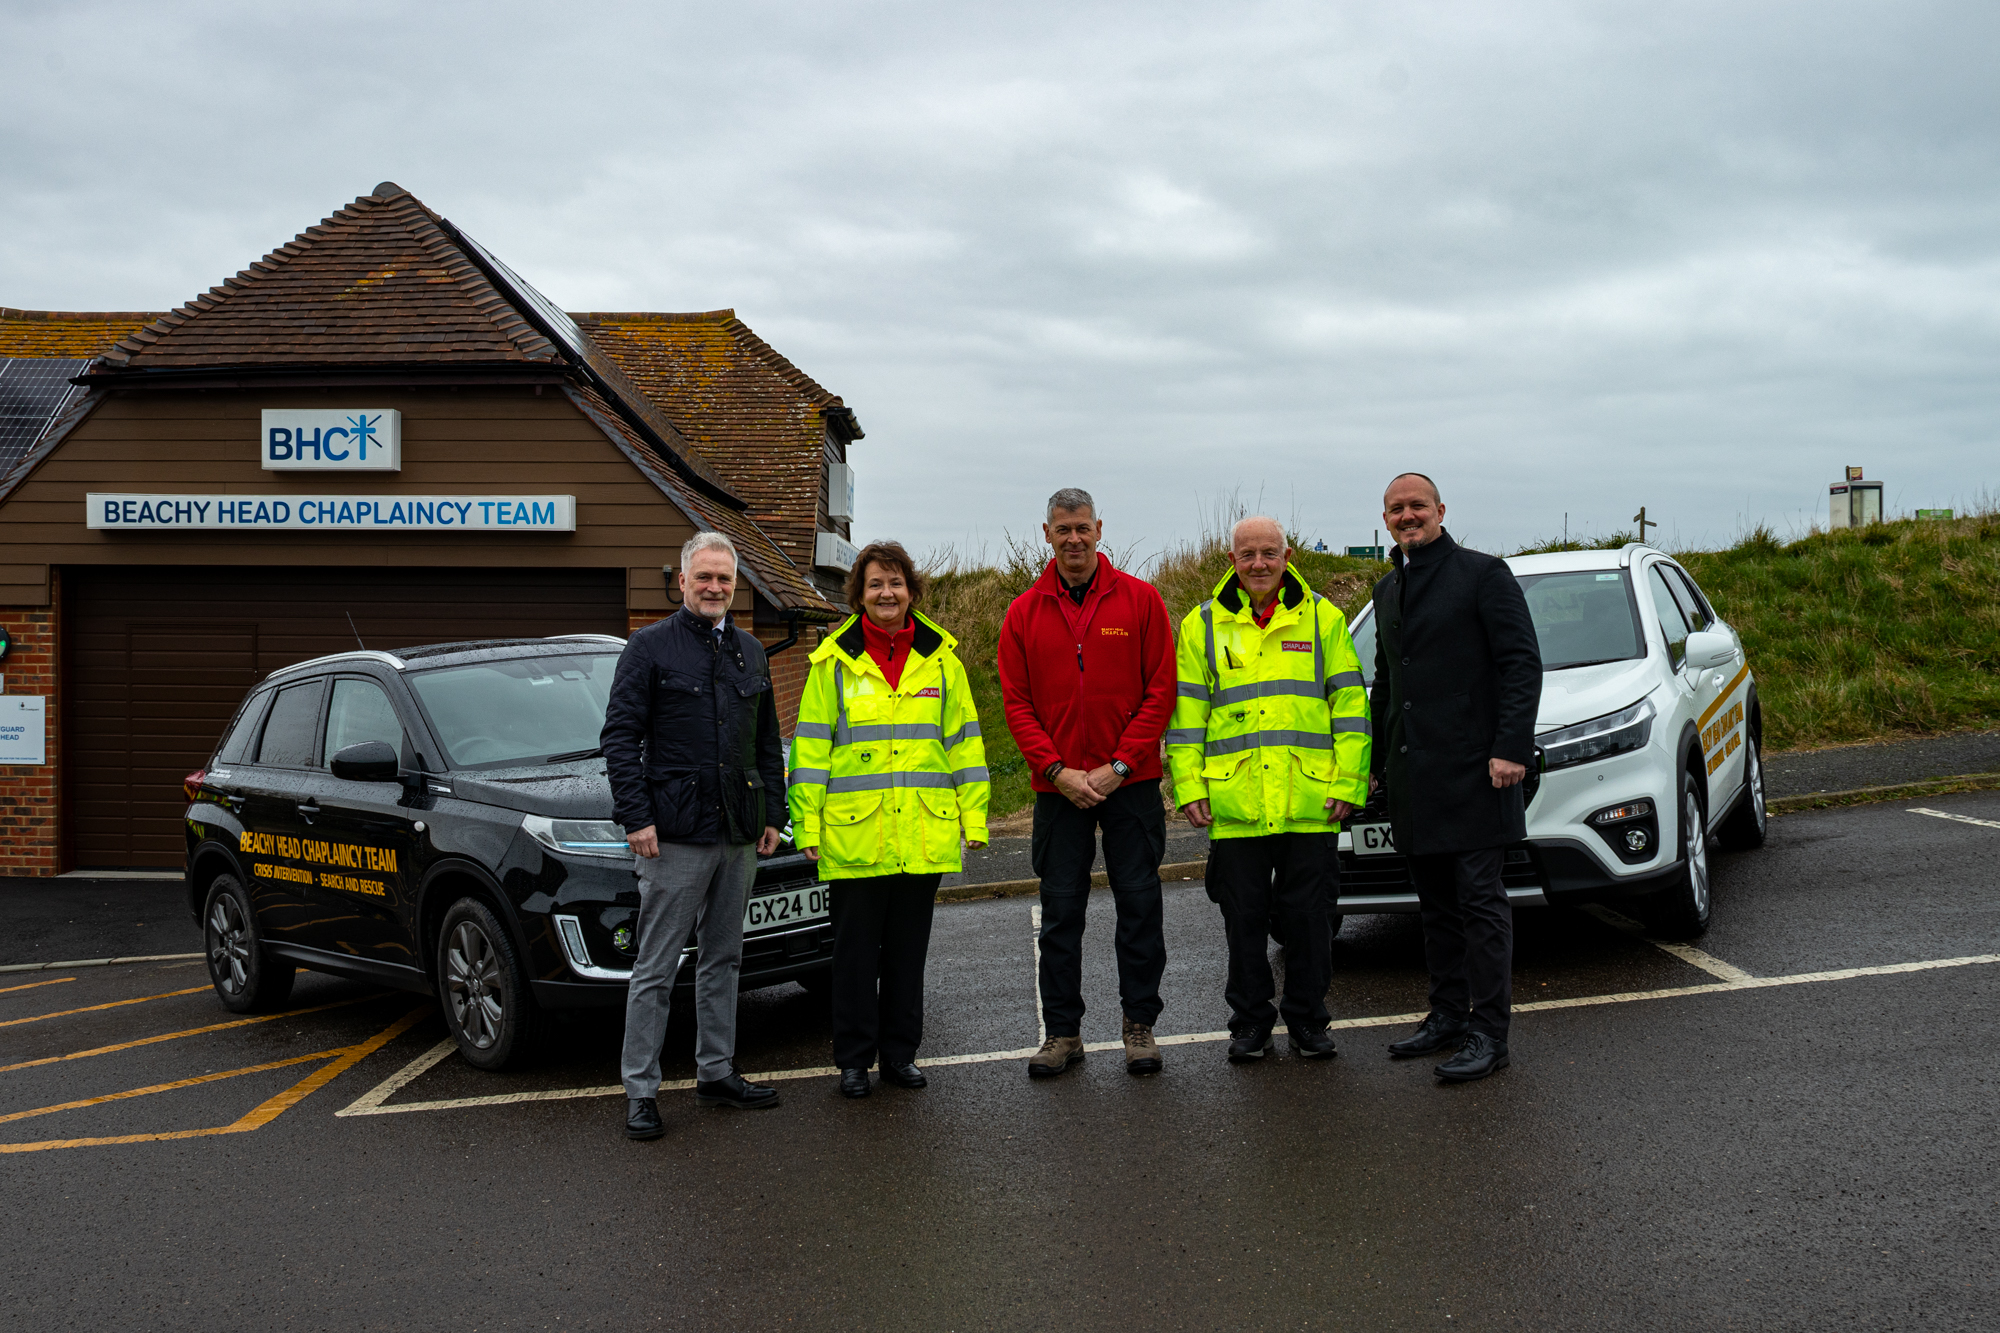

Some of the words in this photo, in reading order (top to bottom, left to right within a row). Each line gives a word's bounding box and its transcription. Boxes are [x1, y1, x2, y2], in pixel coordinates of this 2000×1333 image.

[104, 500, 211, 524] BEACHY
[218, 501, 291, 524] HEAD
[298, 501, 472, 524] CHAPLAINCY
[478, 501, 555, 525] TEAM
[1282, 642, 1311, 650] CHAPLAIN
[240, 831, 276, 856] BEACHY
[276, 835, 301, 859] HEAD
[302, 839, 363, 868] CHAPLAINCY
[364, 846, 398, 873] TEAM
[253, 862, 273, 878] CRISIS
[273, 865, 313, 885] INTERVENTION
[320, 872, 345, 890] SEARCH
[345, 877, 359, 893] AND
[359, 879, 386, 897] RESCUE
[749, 894, 803, 925] GX24
